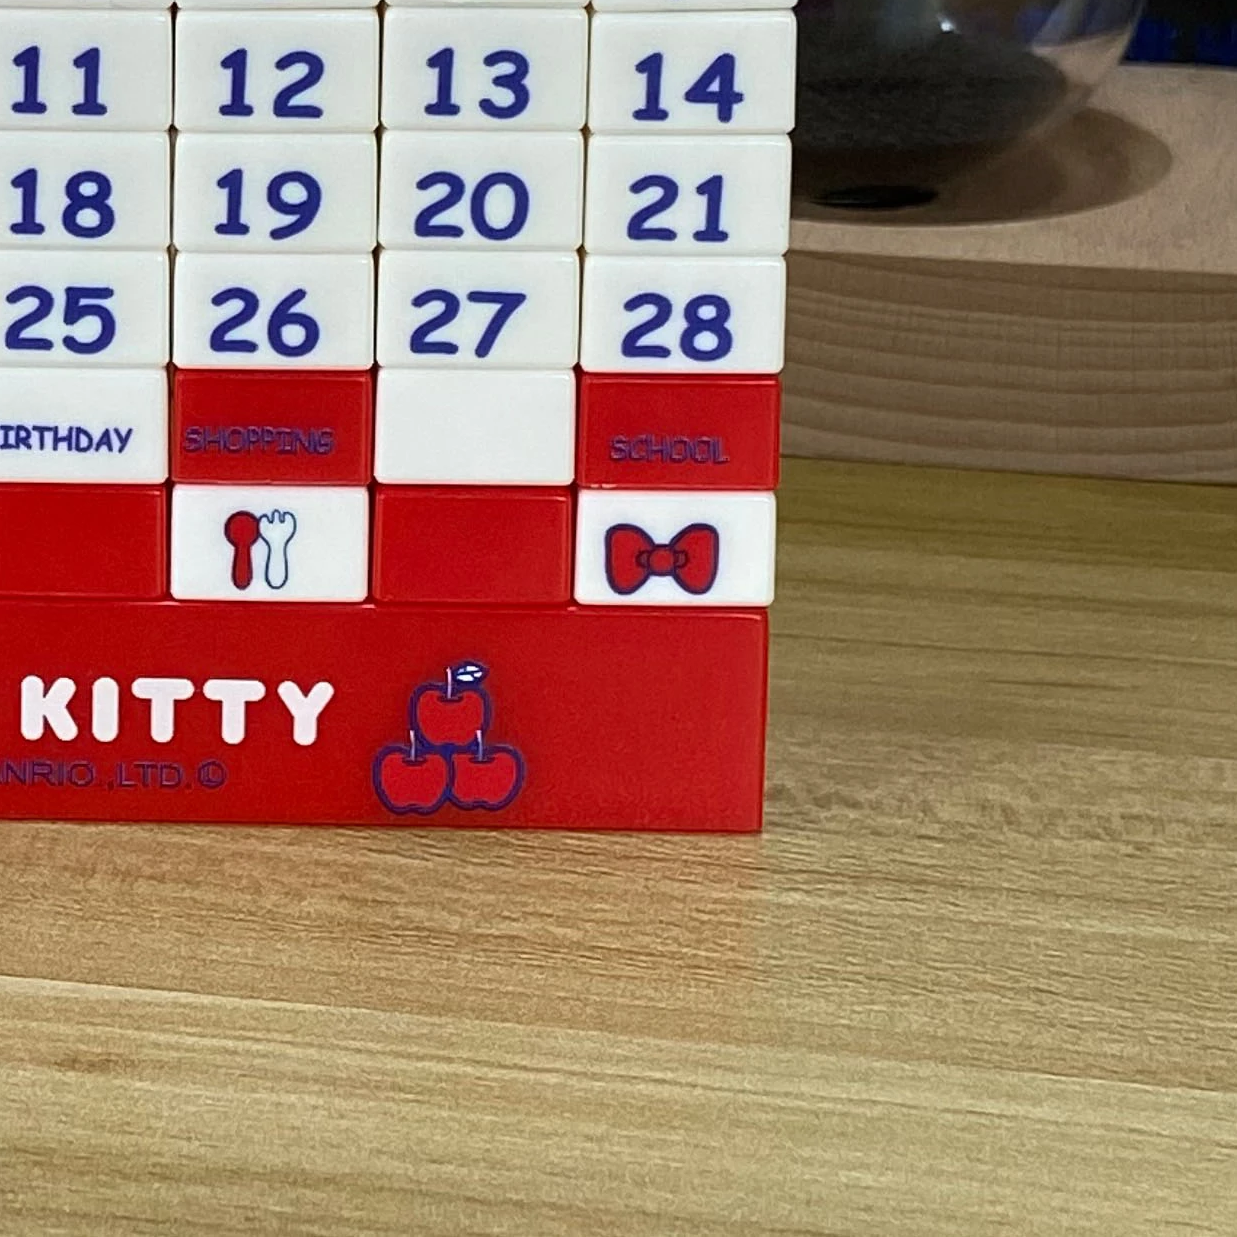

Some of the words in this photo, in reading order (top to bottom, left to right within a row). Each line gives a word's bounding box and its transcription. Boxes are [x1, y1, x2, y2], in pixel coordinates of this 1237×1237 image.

[11, 44, 108, 118] 11
[219, 47, 326, 120] 12
[425, 46, 532, 121] 13
[632, 50, 746, 124] 14
[9, 166, 117, 240] 18
[215, 167, 324, 240] 19
[414, 169, 532, 242] 20
[625, 173, 730, 244] 21
[3, 283, 118, 356] 25
[208, 285, 322, 359] 26
[409, 287, 528, 359] 27
[620, 291, 735, 364] 28
[185, 425, 335, 455] SHOPPING
[610, 434, 730, 464] SCHOOL
[20, 675, 334, 746] KITTY
